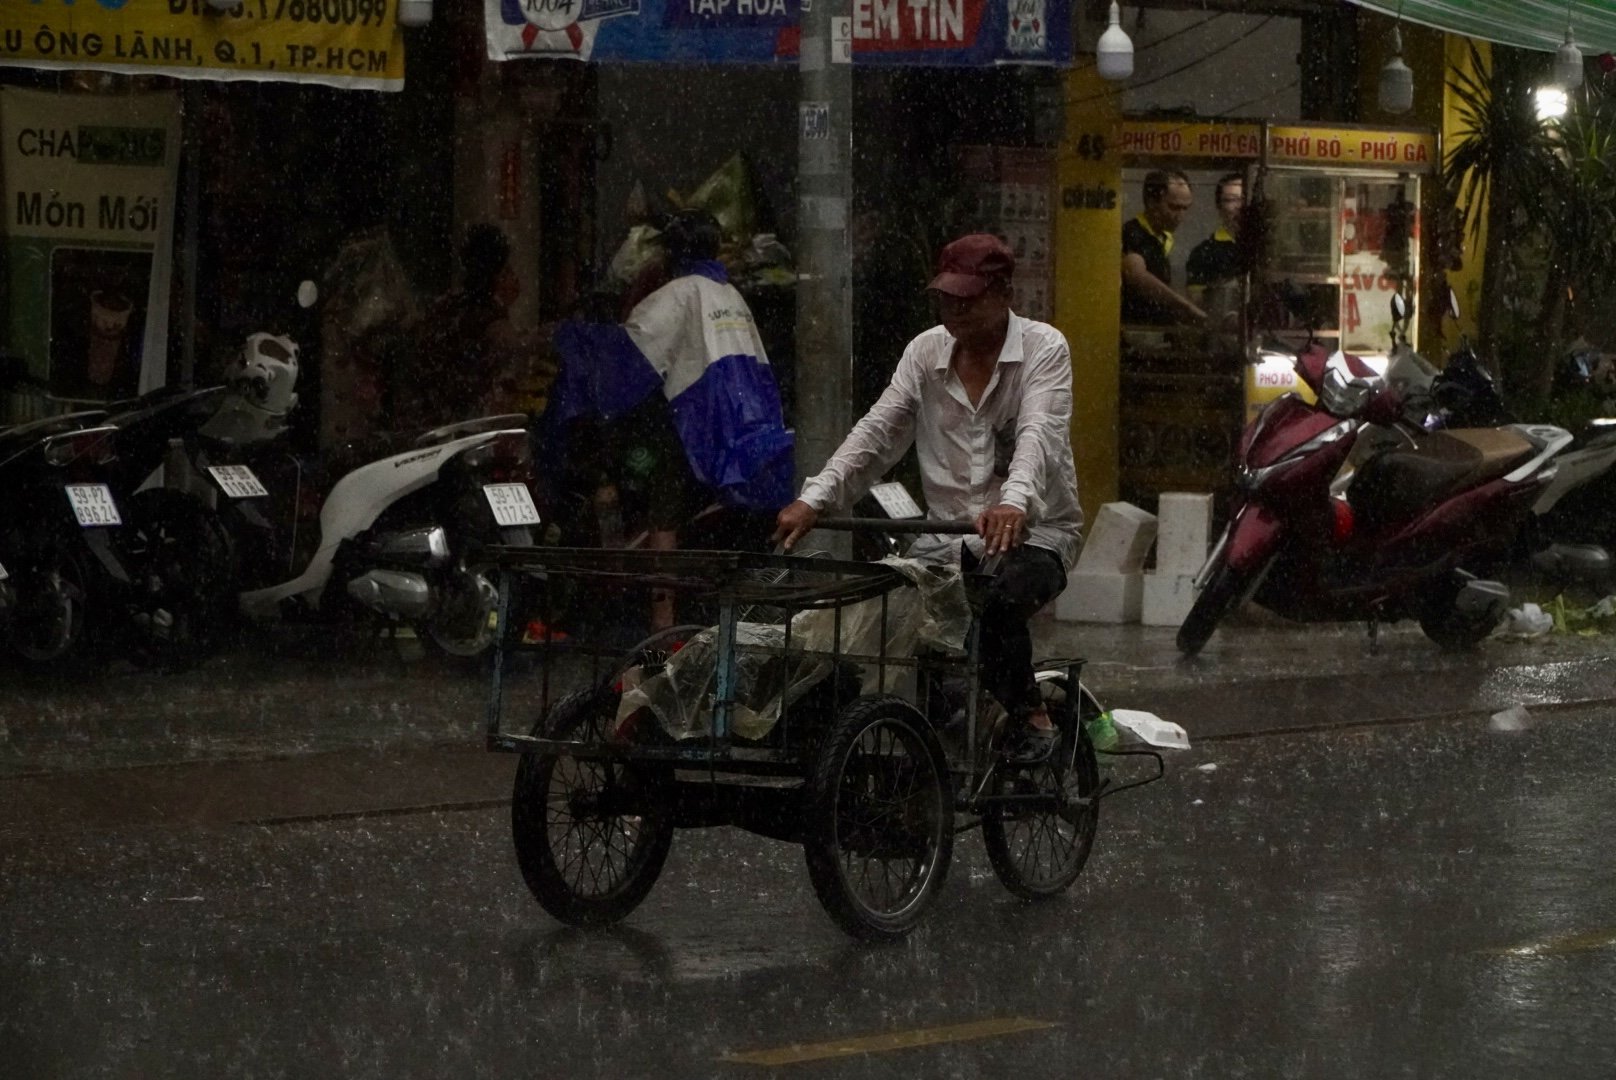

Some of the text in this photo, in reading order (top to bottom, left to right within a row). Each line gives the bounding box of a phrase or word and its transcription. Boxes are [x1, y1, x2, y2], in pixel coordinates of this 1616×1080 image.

[907, 0, 963, 41] TIN
[34, 24, 103, 56] ÔNG
[114, 30, 203, 66] LÃNH,
[286, 44, 388, 72] TP.HCM
[17, 191, 157, 232] Món Mới
